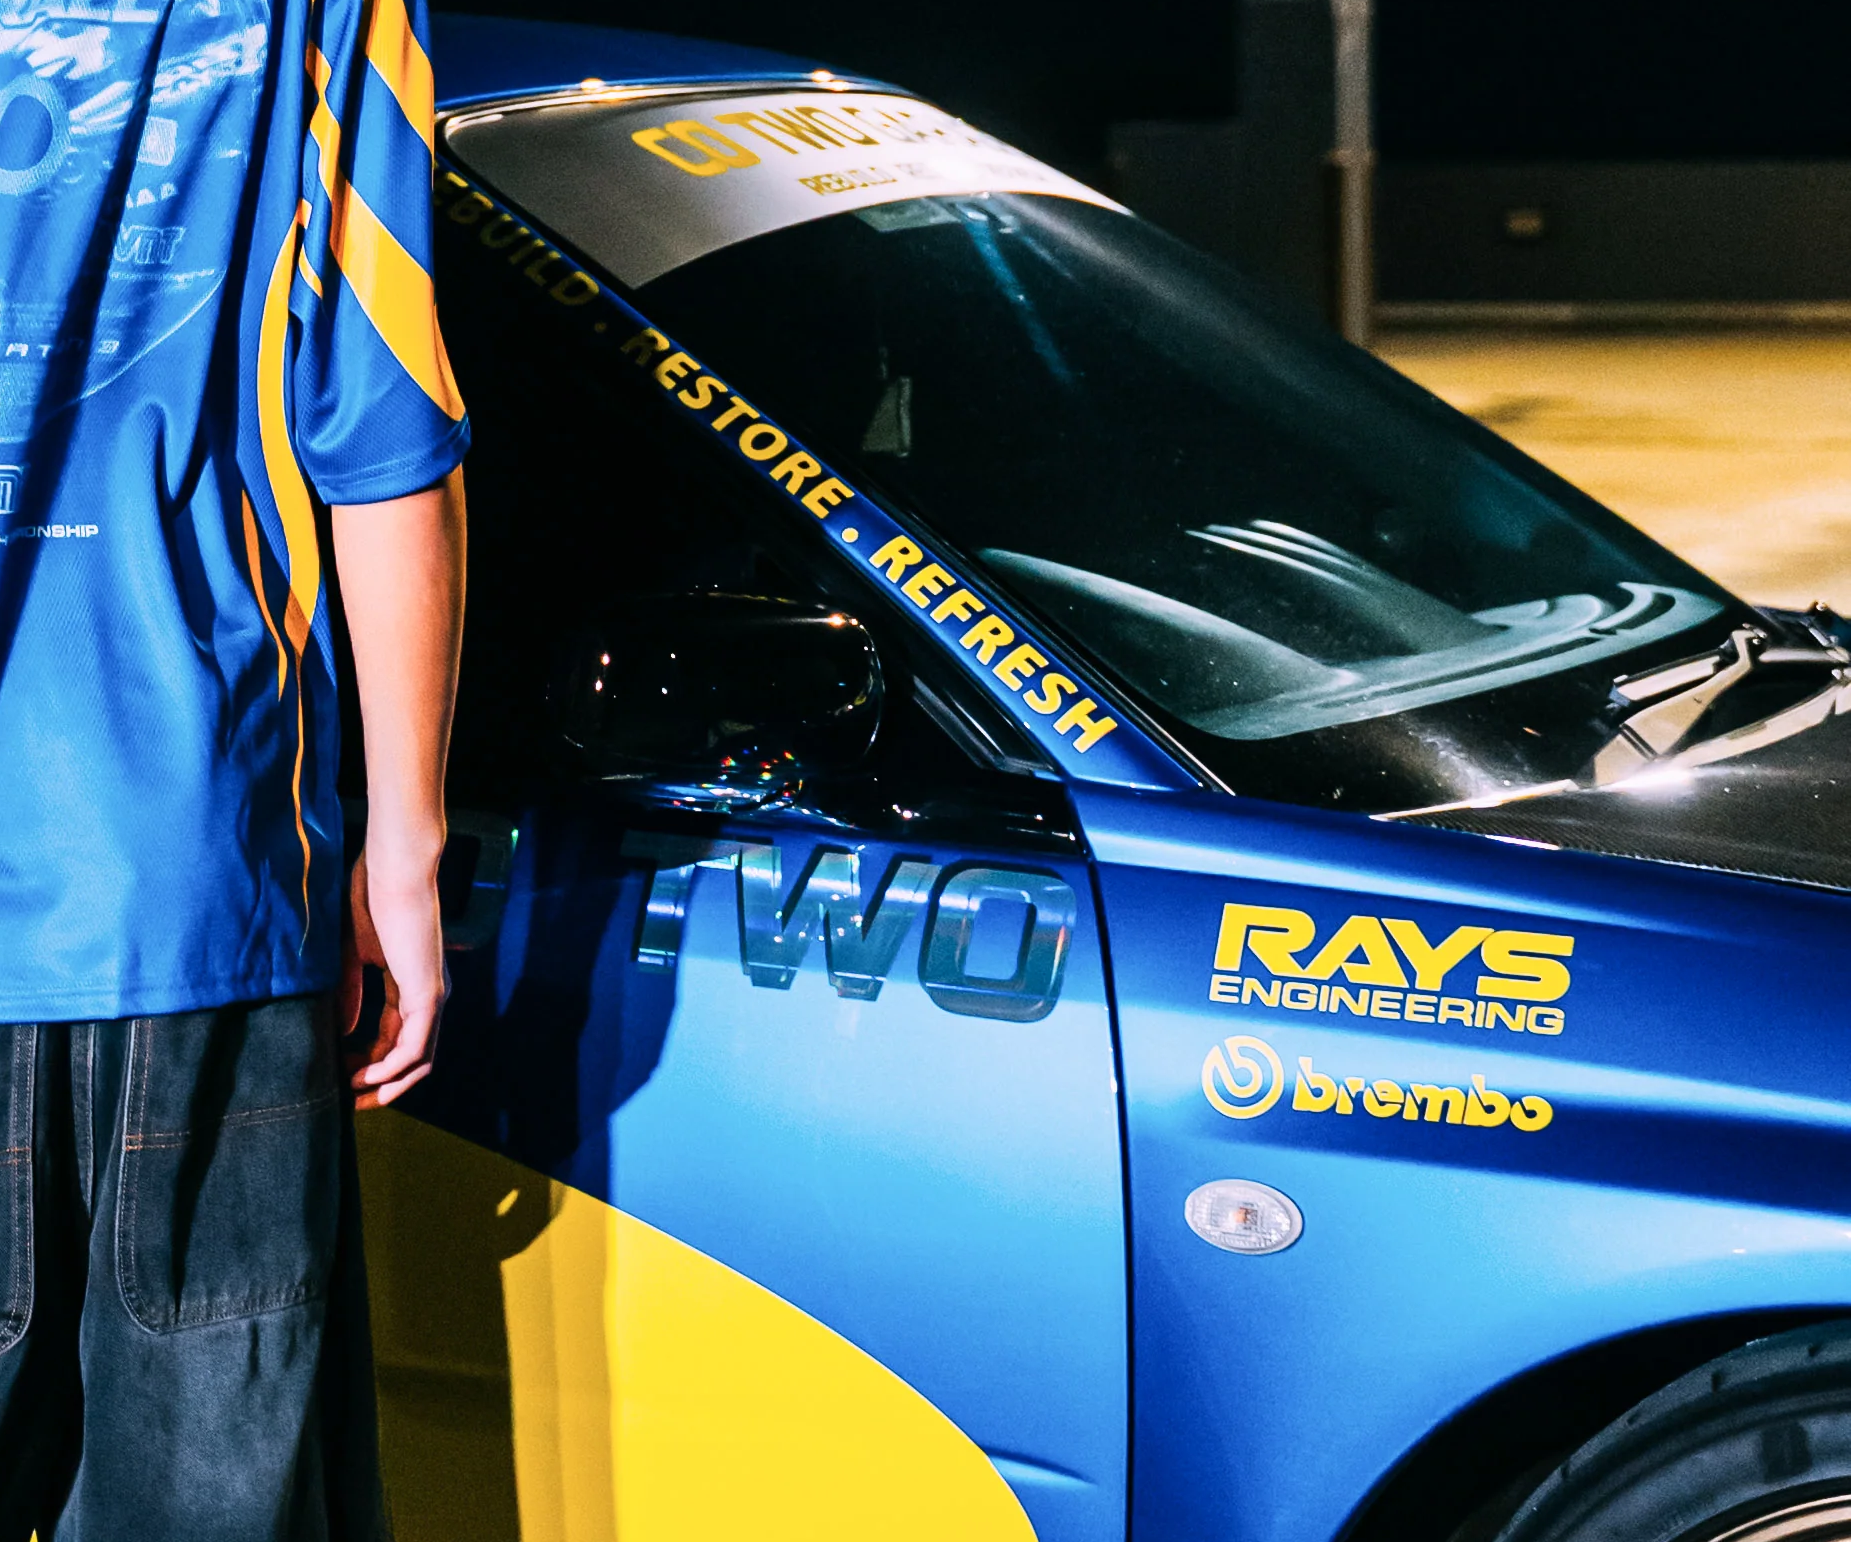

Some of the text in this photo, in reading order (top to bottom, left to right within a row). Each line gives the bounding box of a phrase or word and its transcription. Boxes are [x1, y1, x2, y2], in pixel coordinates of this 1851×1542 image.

[632, 120, 761, 178] CO
[713, 106, 880, 155] TWO
[432, 168, 1118, 754] EBUILD RESTORE REFRESH
[1213, 902, 1575, 1002] RAYS
[1208, 973, 1565, 1036] ENGINEERING
[1292, 1056, 1554, 1132] brembo
